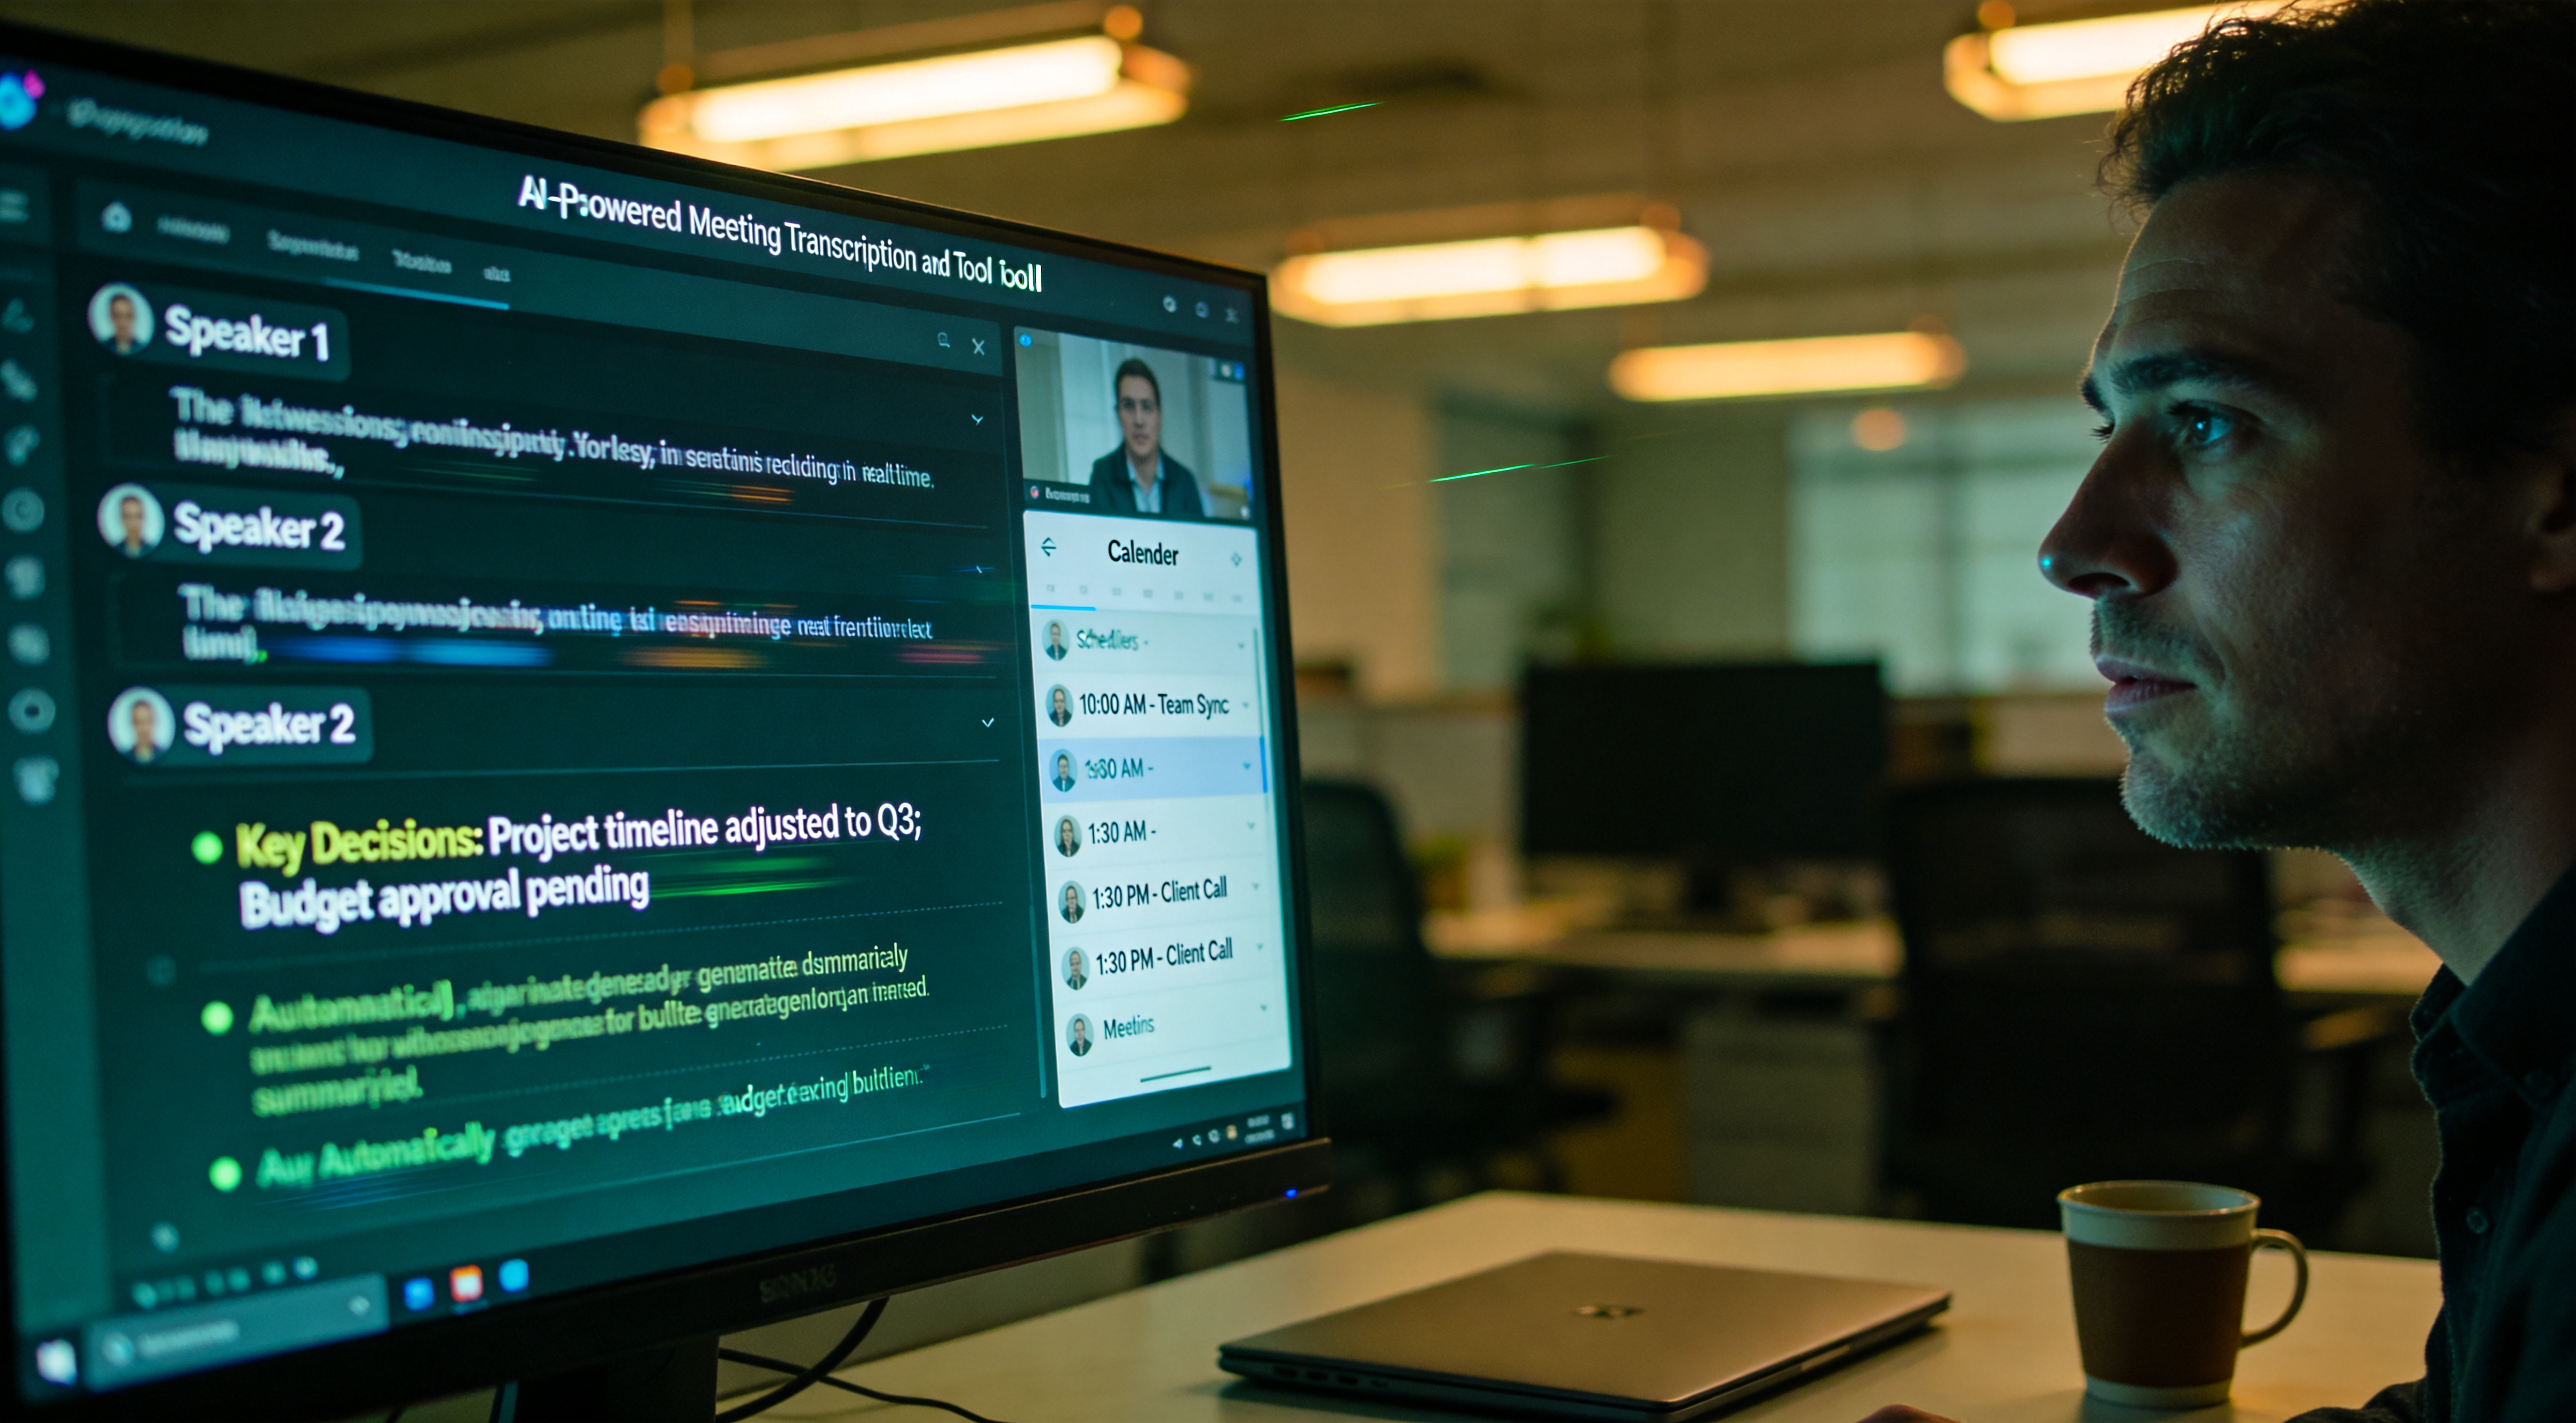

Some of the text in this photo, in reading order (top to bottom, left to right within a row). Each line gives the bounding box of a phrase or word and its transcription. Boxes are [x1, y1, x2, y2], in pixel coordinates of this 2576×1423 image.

[689, 205, 782, 256] Meeting
[785, 222, 917, 271] Transcription
[922, 249, 950, 277] and
[953, 251, 992, 284] Tool
[165, 304, 329, 362] Speaker 1
[174, 499, 346, 554] Speaker 2
[1108, 539, 1179, 566] Calender
[183, 702, 356, 757] Speaker 2
[1079, 693, 1120, 715] 10:00
[1123, 693, 1147, 715] AM
[1158, 694, 1194, 715] Team
[1197, 693, 1230, 720] Sync
[1121, 757, 1144, 778] AM
[236, 802, 922, 878] Key Decisions: Project timeline adjusted to Q3;
[1088, 822, 1119, 844] 1:30
[1123, 820, 1147, 843] AM
[239, 864, 651, 935] Budget approval pending
[1092, 886, 1123, 910] 1:30
[1127, 883, 1149, 907] PM
[1161, 880, 1200, 904] Client
[1203, 875, 1228, 898] Call
[1096, 951, 1127, 976] 1:30
[1131, 947, 1154, 972] PM
[1166, 943, 1206, 967] Client
[1208, 937, 1233, 961] Call
